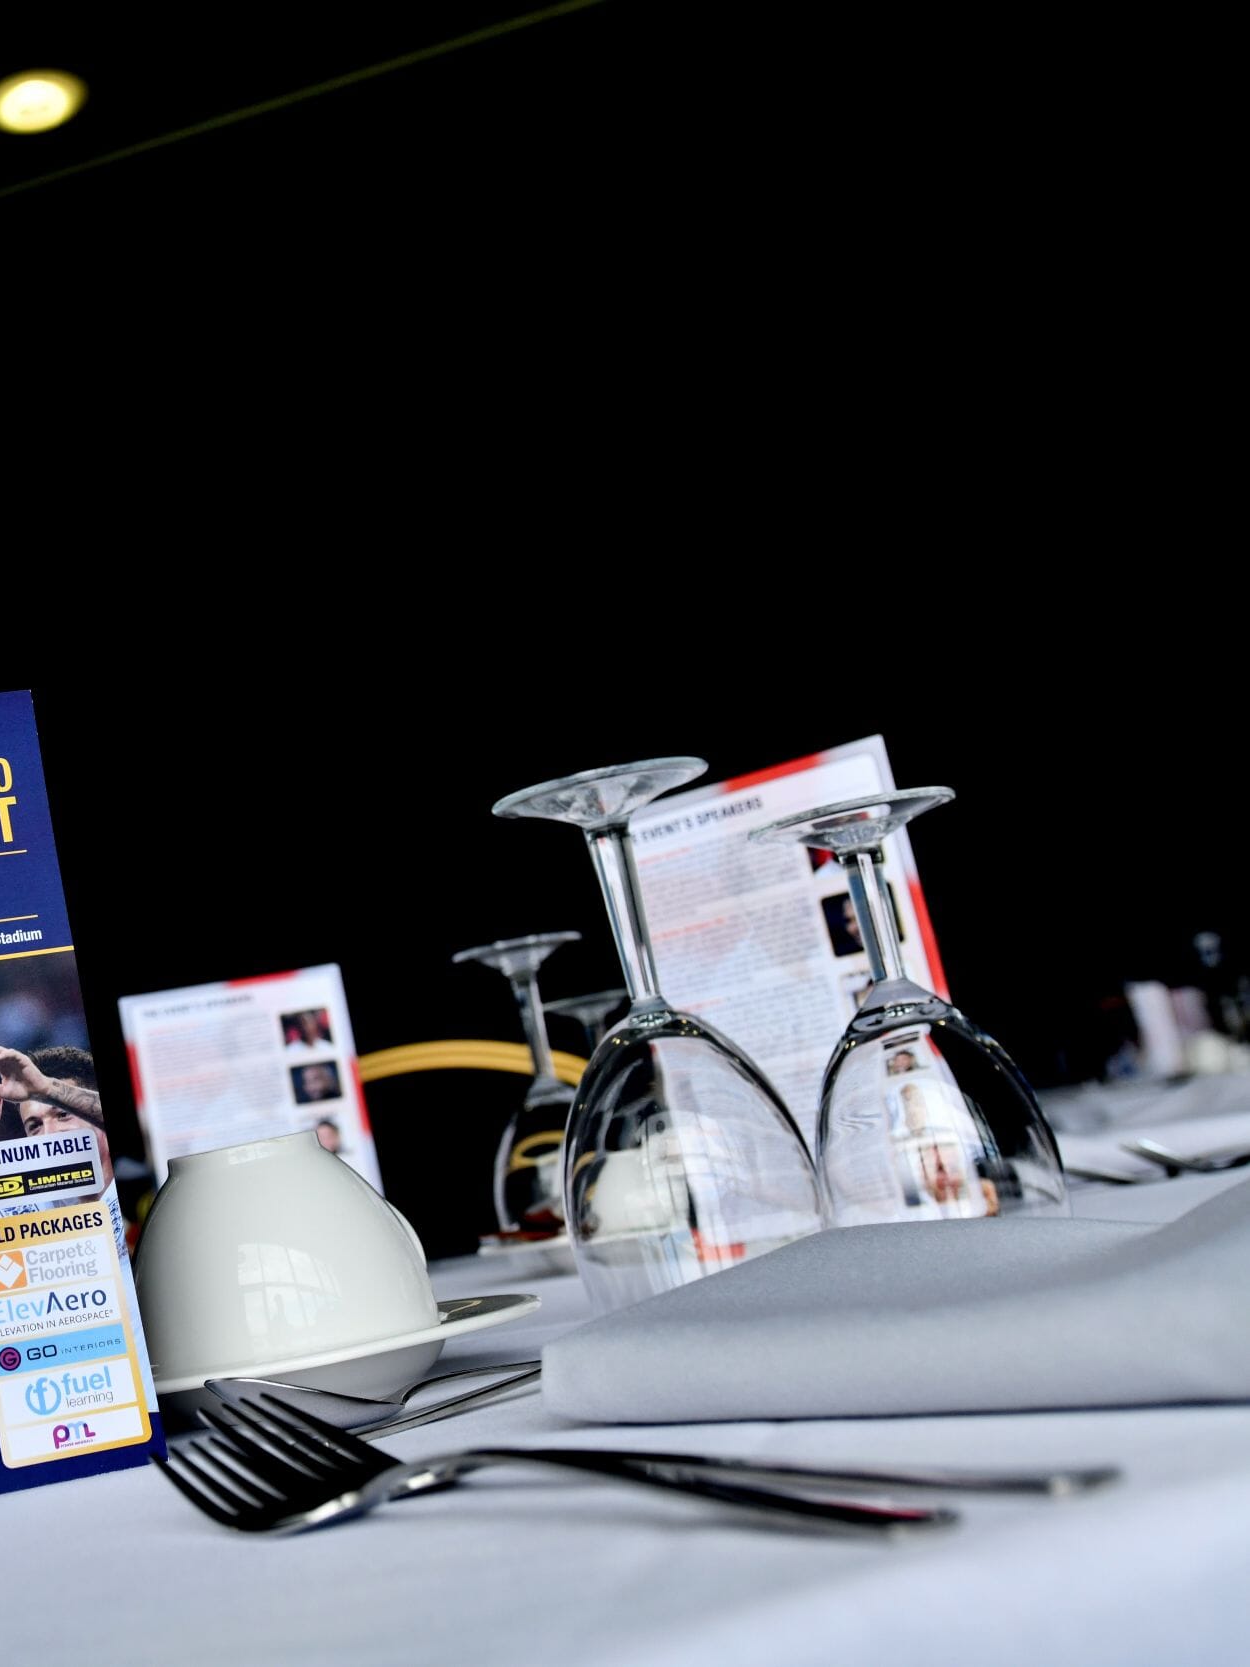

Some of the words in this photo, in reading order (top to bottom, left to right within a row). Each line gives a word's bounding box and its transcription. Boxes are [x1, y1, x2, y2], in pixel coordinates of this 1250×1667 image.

[43, 1136, 92, 1156] TABLE
[28, 1169, 93, 1187] LIMITED
[19, 1212, 103, 1239] PACKAGES
[28, 1258, 98, 1284] Flooring
[46, 1320, 56, 1329] IN
[26, 1344, 57, 1361] GO
[61, 1338, 121, 1354] INTERIORS
[61, 1365, 112, 1395] fuel
[66, 1390, 114, 1408] learning
